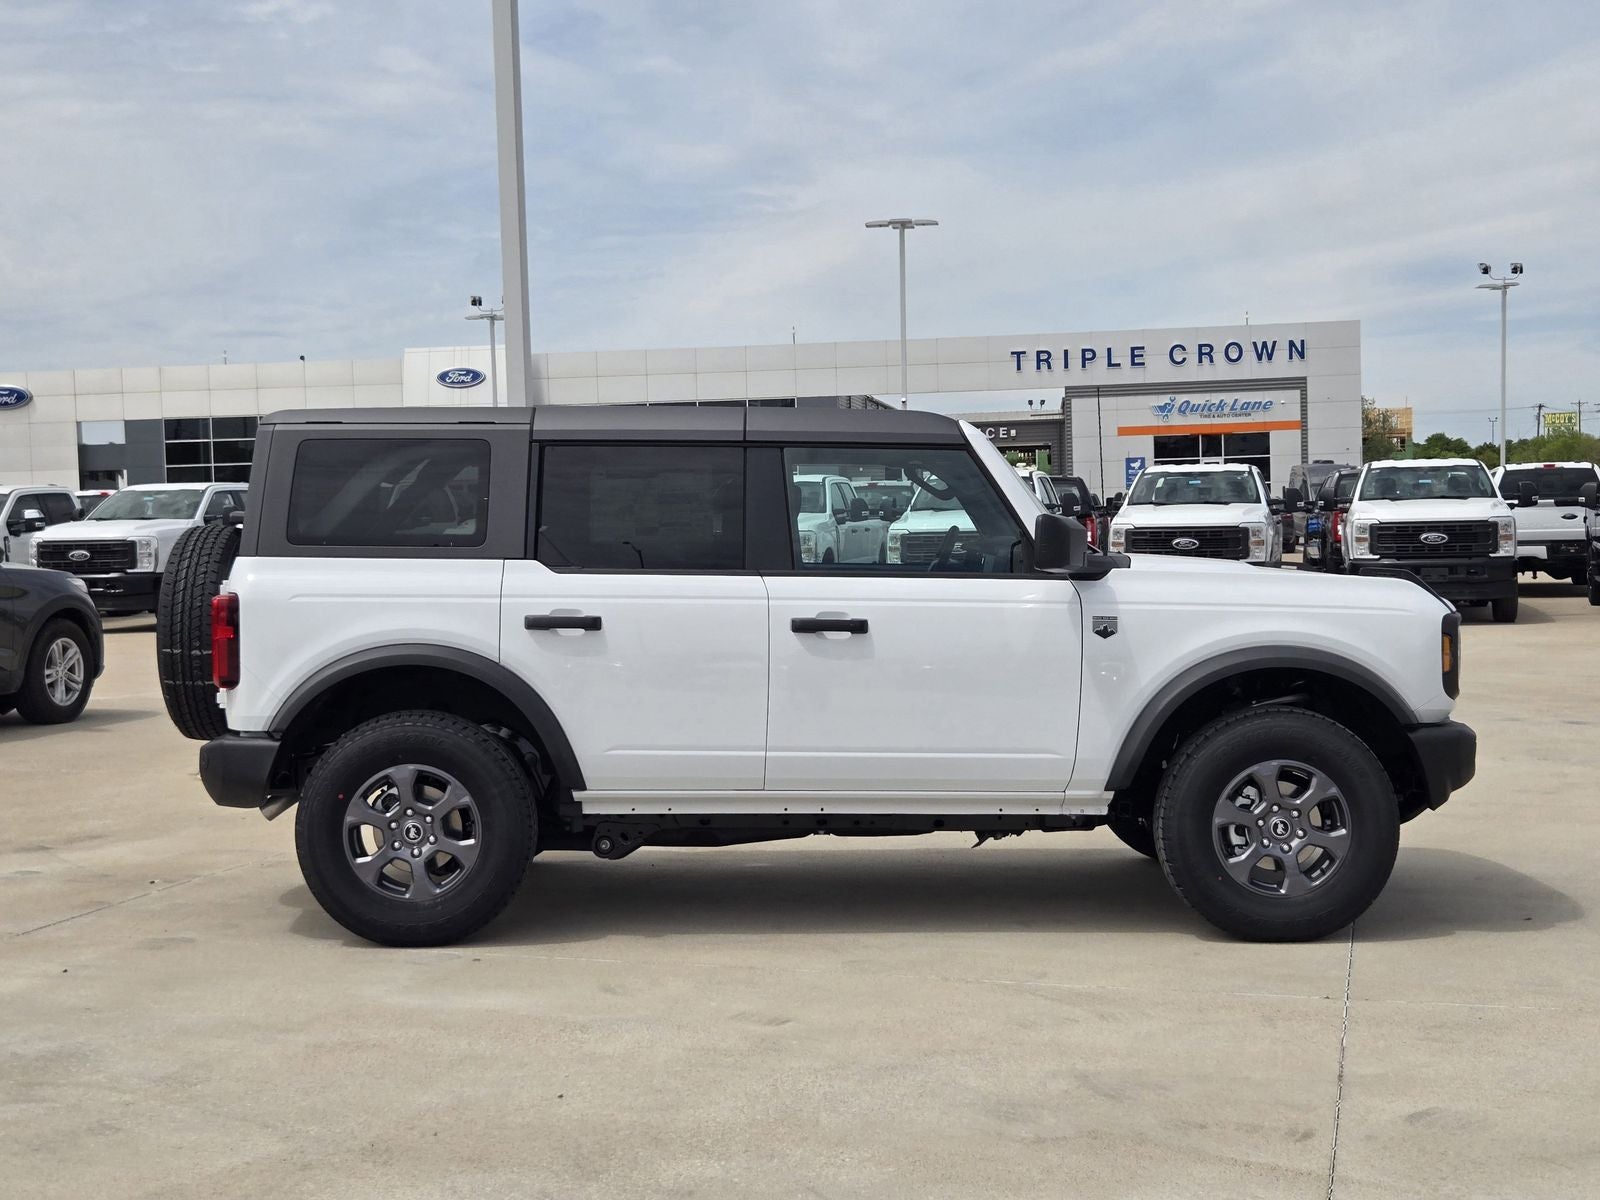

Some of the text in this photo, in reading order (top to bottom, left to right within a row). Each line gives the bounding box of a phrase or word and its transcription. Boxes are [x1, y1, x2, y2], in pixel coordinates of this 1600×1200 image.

[1010, 338, 1306, 372] TRIPLE CROWN
[446, 370, 473, 383] Ford
[1177, 398, 1273, 416] Quick Lane
[978, 427, 1008, 439] CE
